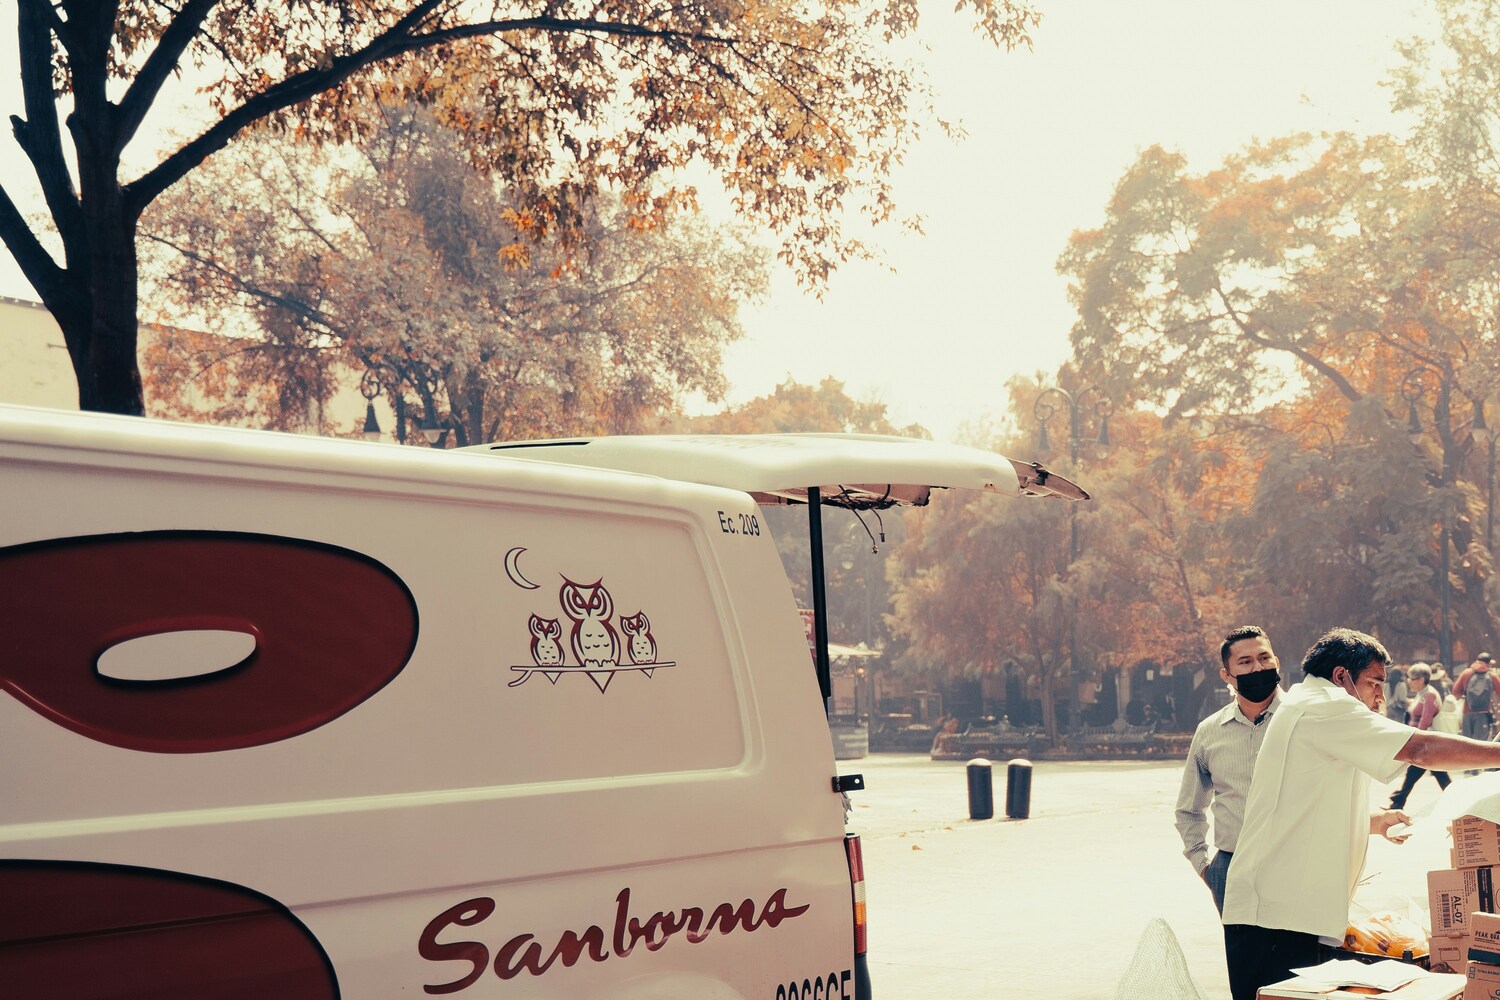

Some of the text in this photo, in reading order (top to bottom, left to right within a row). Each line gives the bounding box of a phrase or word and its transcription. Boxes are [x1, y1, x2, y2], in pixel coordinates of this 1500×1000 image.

[717, 510, 761, 537] Ec. 209
[1453, 895, 1463, 924] AL-07
[418, 887, 811, 995] Sanborns
[1475, 930, 1488, 939] PEAK
